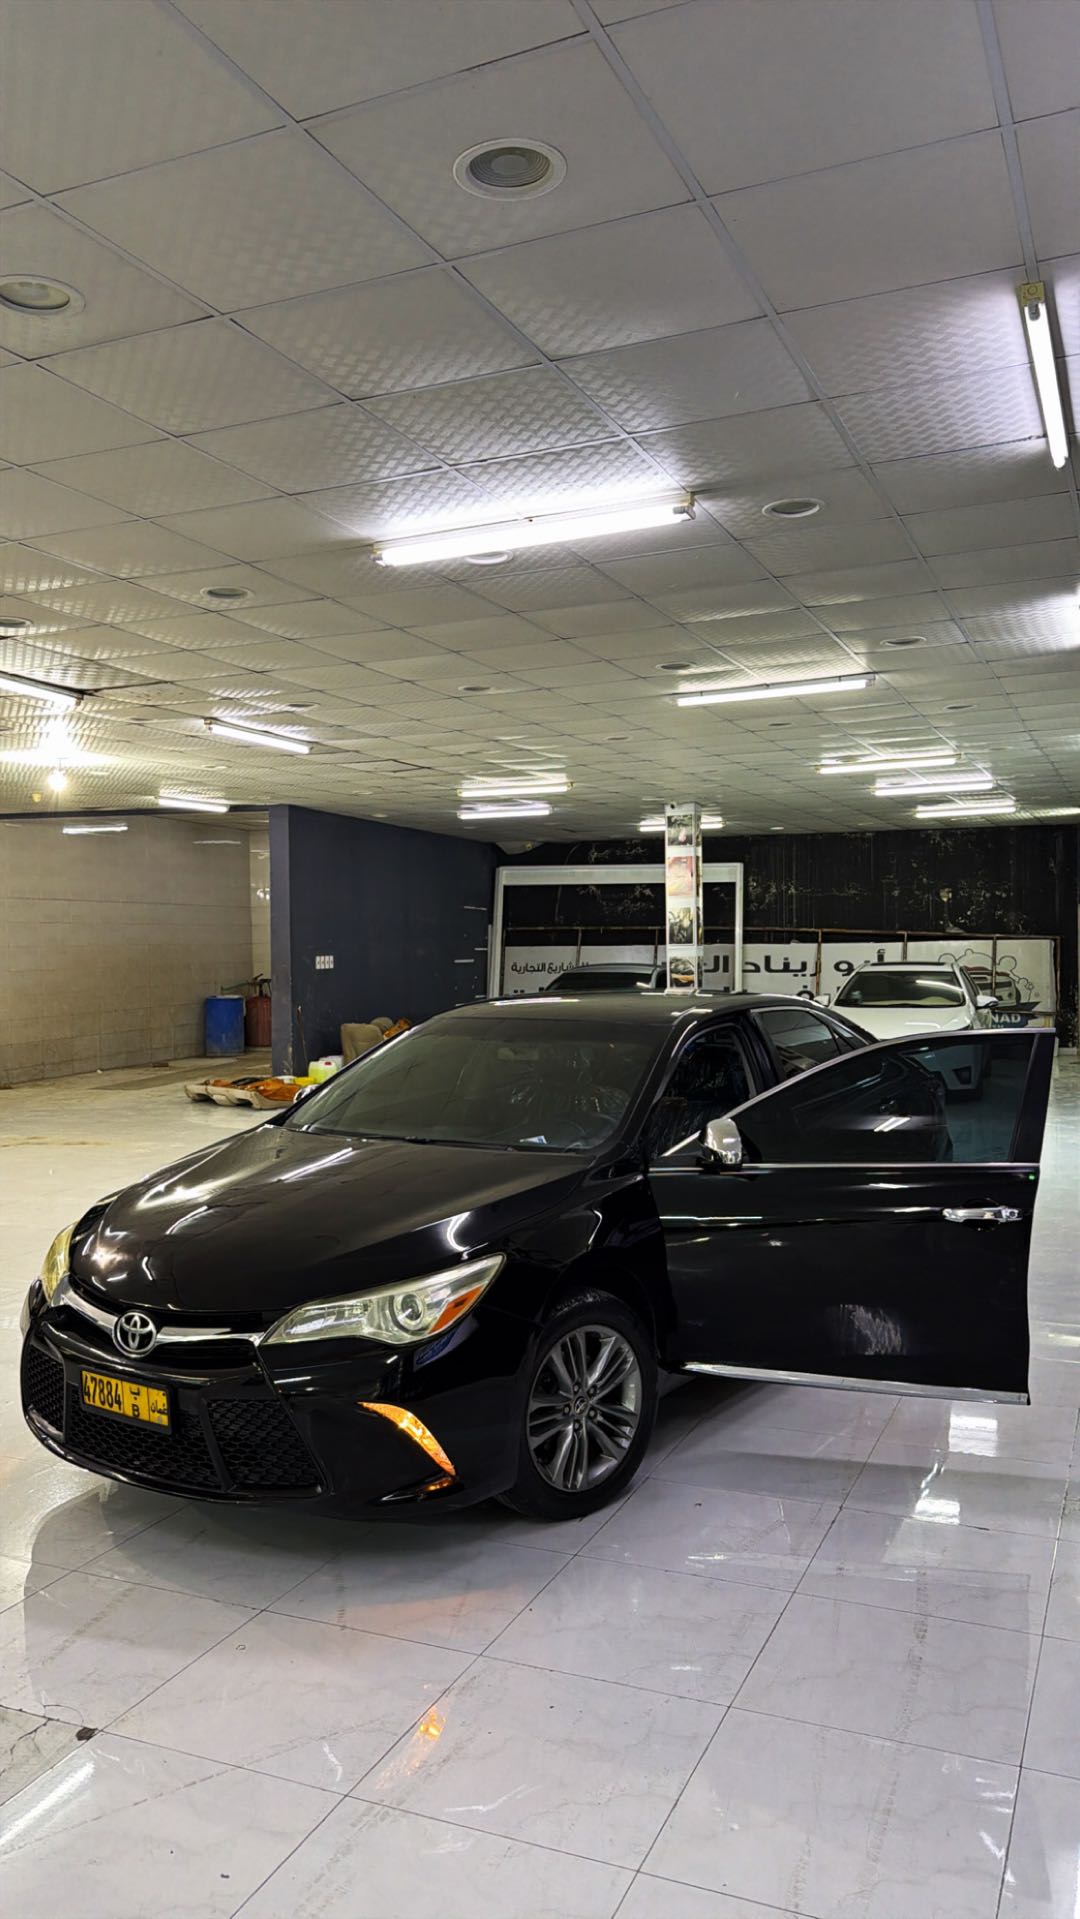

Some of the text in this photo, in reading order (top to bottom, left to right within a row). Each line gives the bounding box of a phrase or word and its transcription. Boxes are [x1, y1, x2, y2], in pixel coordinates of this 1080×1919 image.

[510, 961, 546, 975] التجارية
[742, 955, 822, 977] ريناد
[834, 948, 886, 977] أو
[991, 1013, 1021, 1023] NAD
[83, 1374, 121, 1411] 47884
[130, 1388, 140, 1400] ب
[132, 1404, 140, 1418] B
